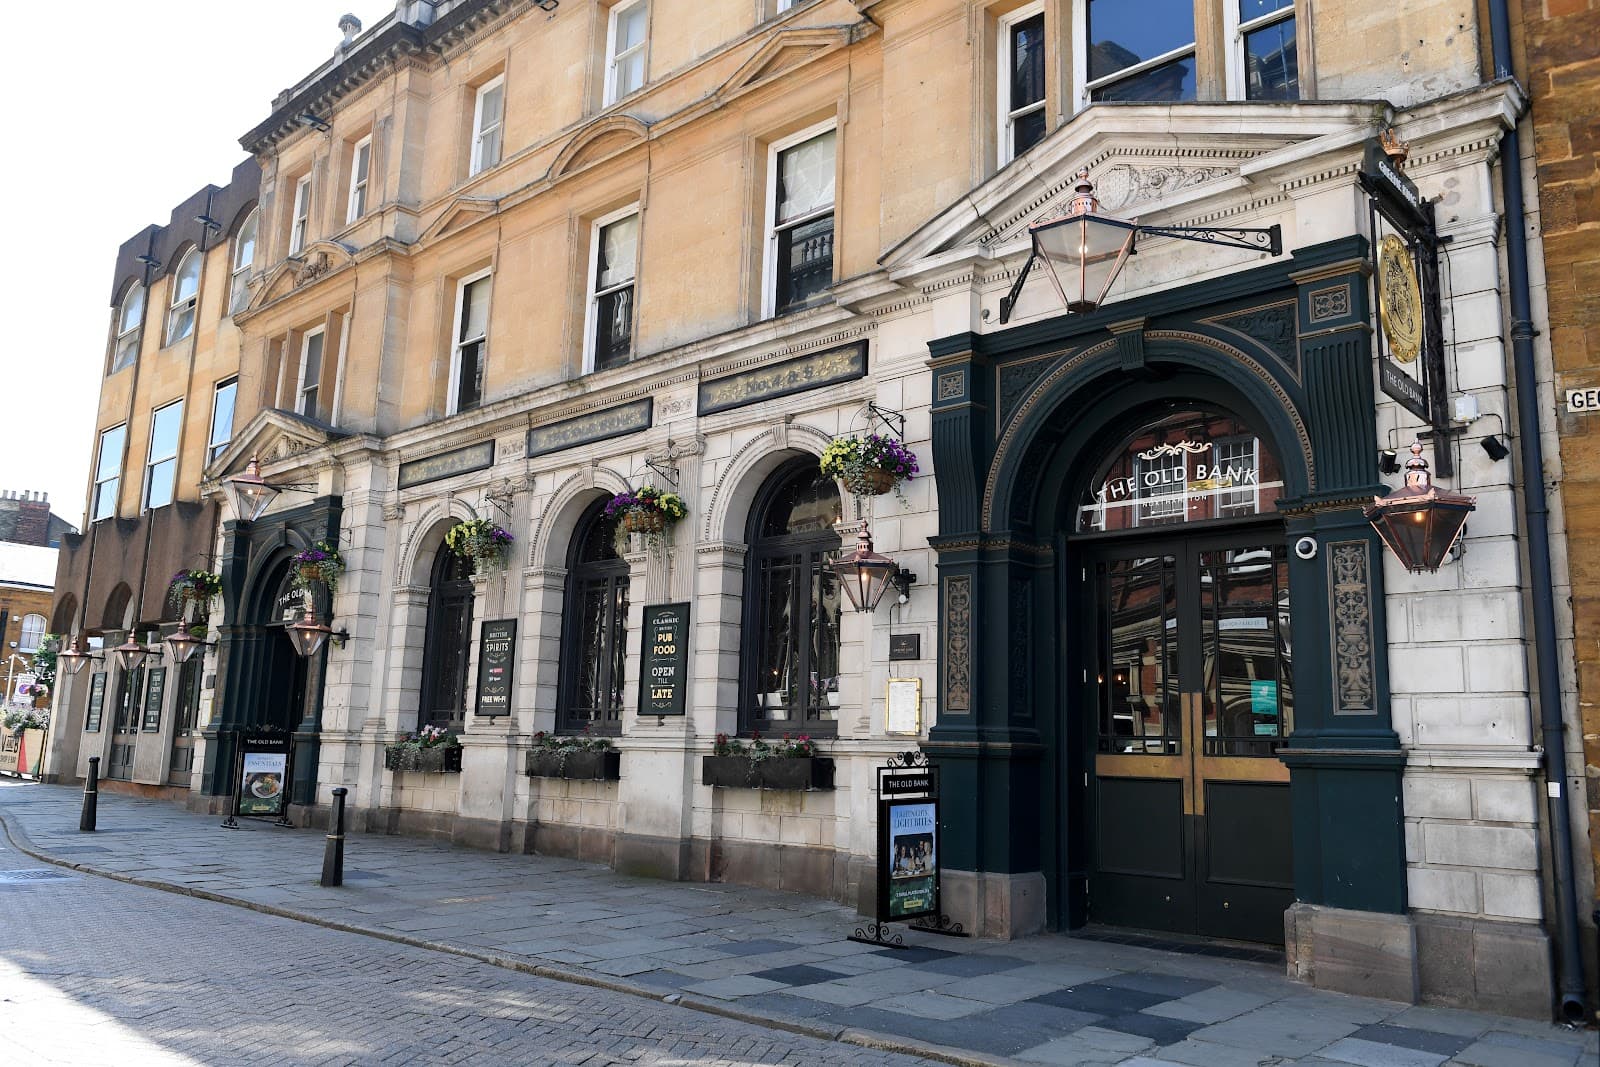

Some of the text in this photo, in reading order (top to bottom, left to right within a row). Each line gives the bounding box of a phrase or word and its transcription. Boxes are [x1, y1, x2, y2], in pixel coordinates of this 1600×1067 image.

[1386, 370, 1423, 407] THE OLD BANK
[1572, 391, 1600, 408] GE
[1096, 464, 1259, 503] THE OLD BANK
[1142, 495, 1207, 508] NORTHAMTON
[279, 588, 303, 606] THE OLD
[652, 617, 679, 625] CLASSIC
[658, 632, 673, 642] PUB
[486, 642, 509, 652] SPIRITS
[653, 645, 676, 655] FOOD
[651, 666, 675, 677] OPEN
[481, 695, 493, 703] FREE
[651, 689, 673, 699] LATE
[889, 779, 929, 788] THE OLD BANK
